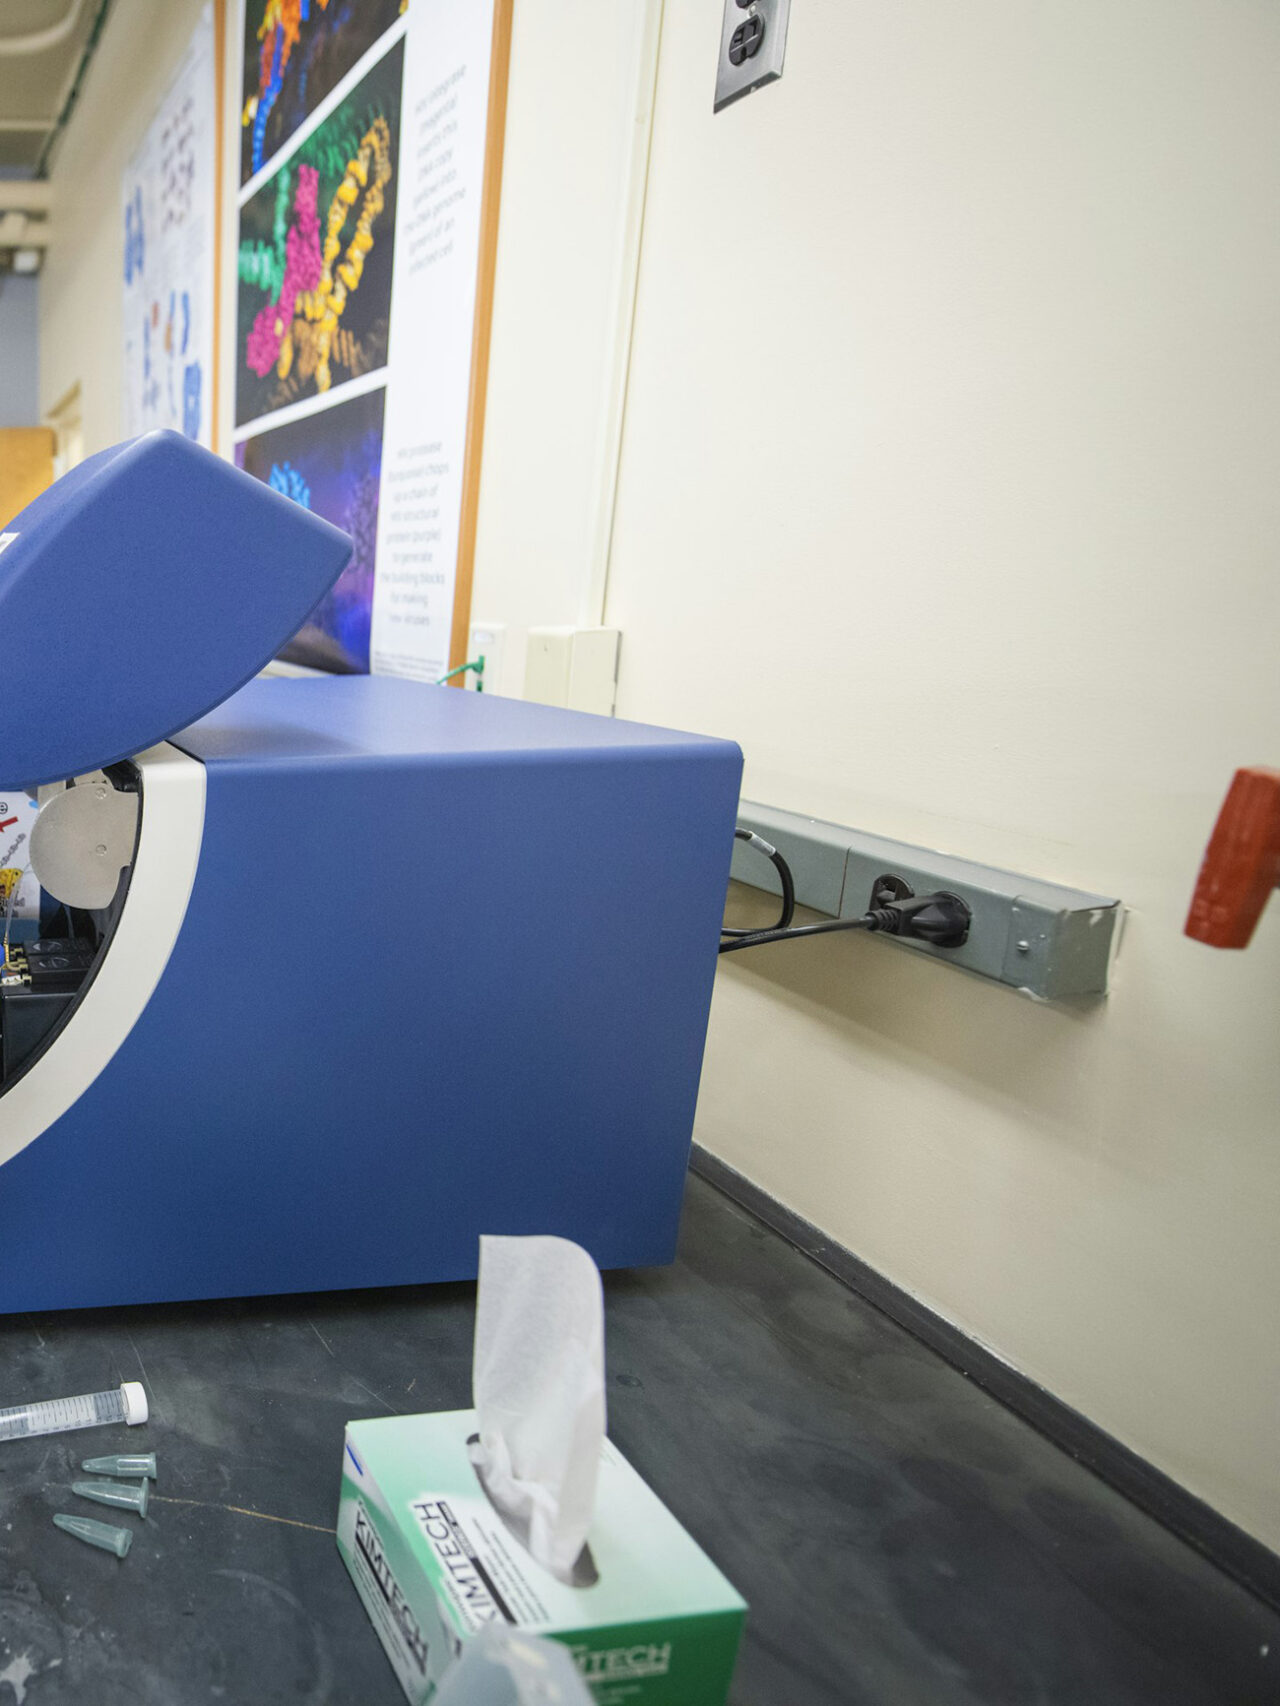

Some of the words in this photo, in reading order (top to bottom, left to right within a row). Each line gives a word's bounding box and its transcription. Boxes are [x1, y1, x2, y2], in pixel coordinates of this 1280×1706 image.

[354, 1509, 429, 1660] KIMTECH
[413, 1502, 498, 1621] KIMTECH
[572, 1641, 672, 1674] TECH
